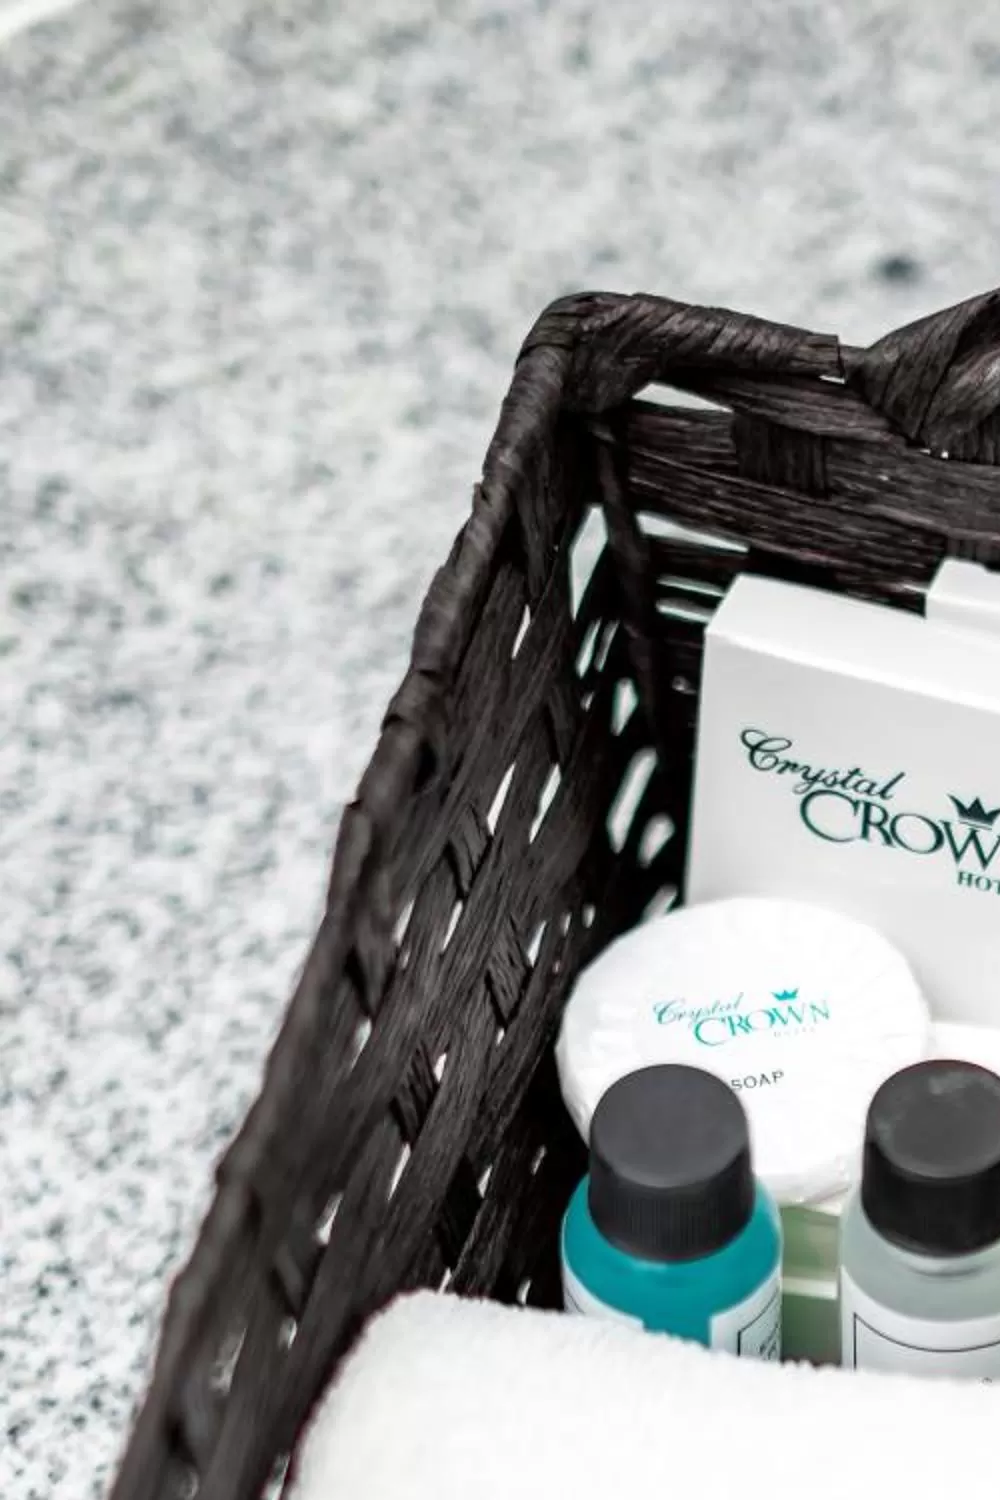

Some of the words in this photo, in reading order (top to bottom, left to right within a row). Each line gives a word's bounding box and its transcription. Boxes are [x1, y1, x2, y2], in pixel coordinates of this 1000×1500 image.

[740, 729, 905, 800] Crystal
[653, 991, 744, 1029] Crystal
[694, 999, 831, 1046] CROWN
[731, 1070, 785, 1091] SOAP
